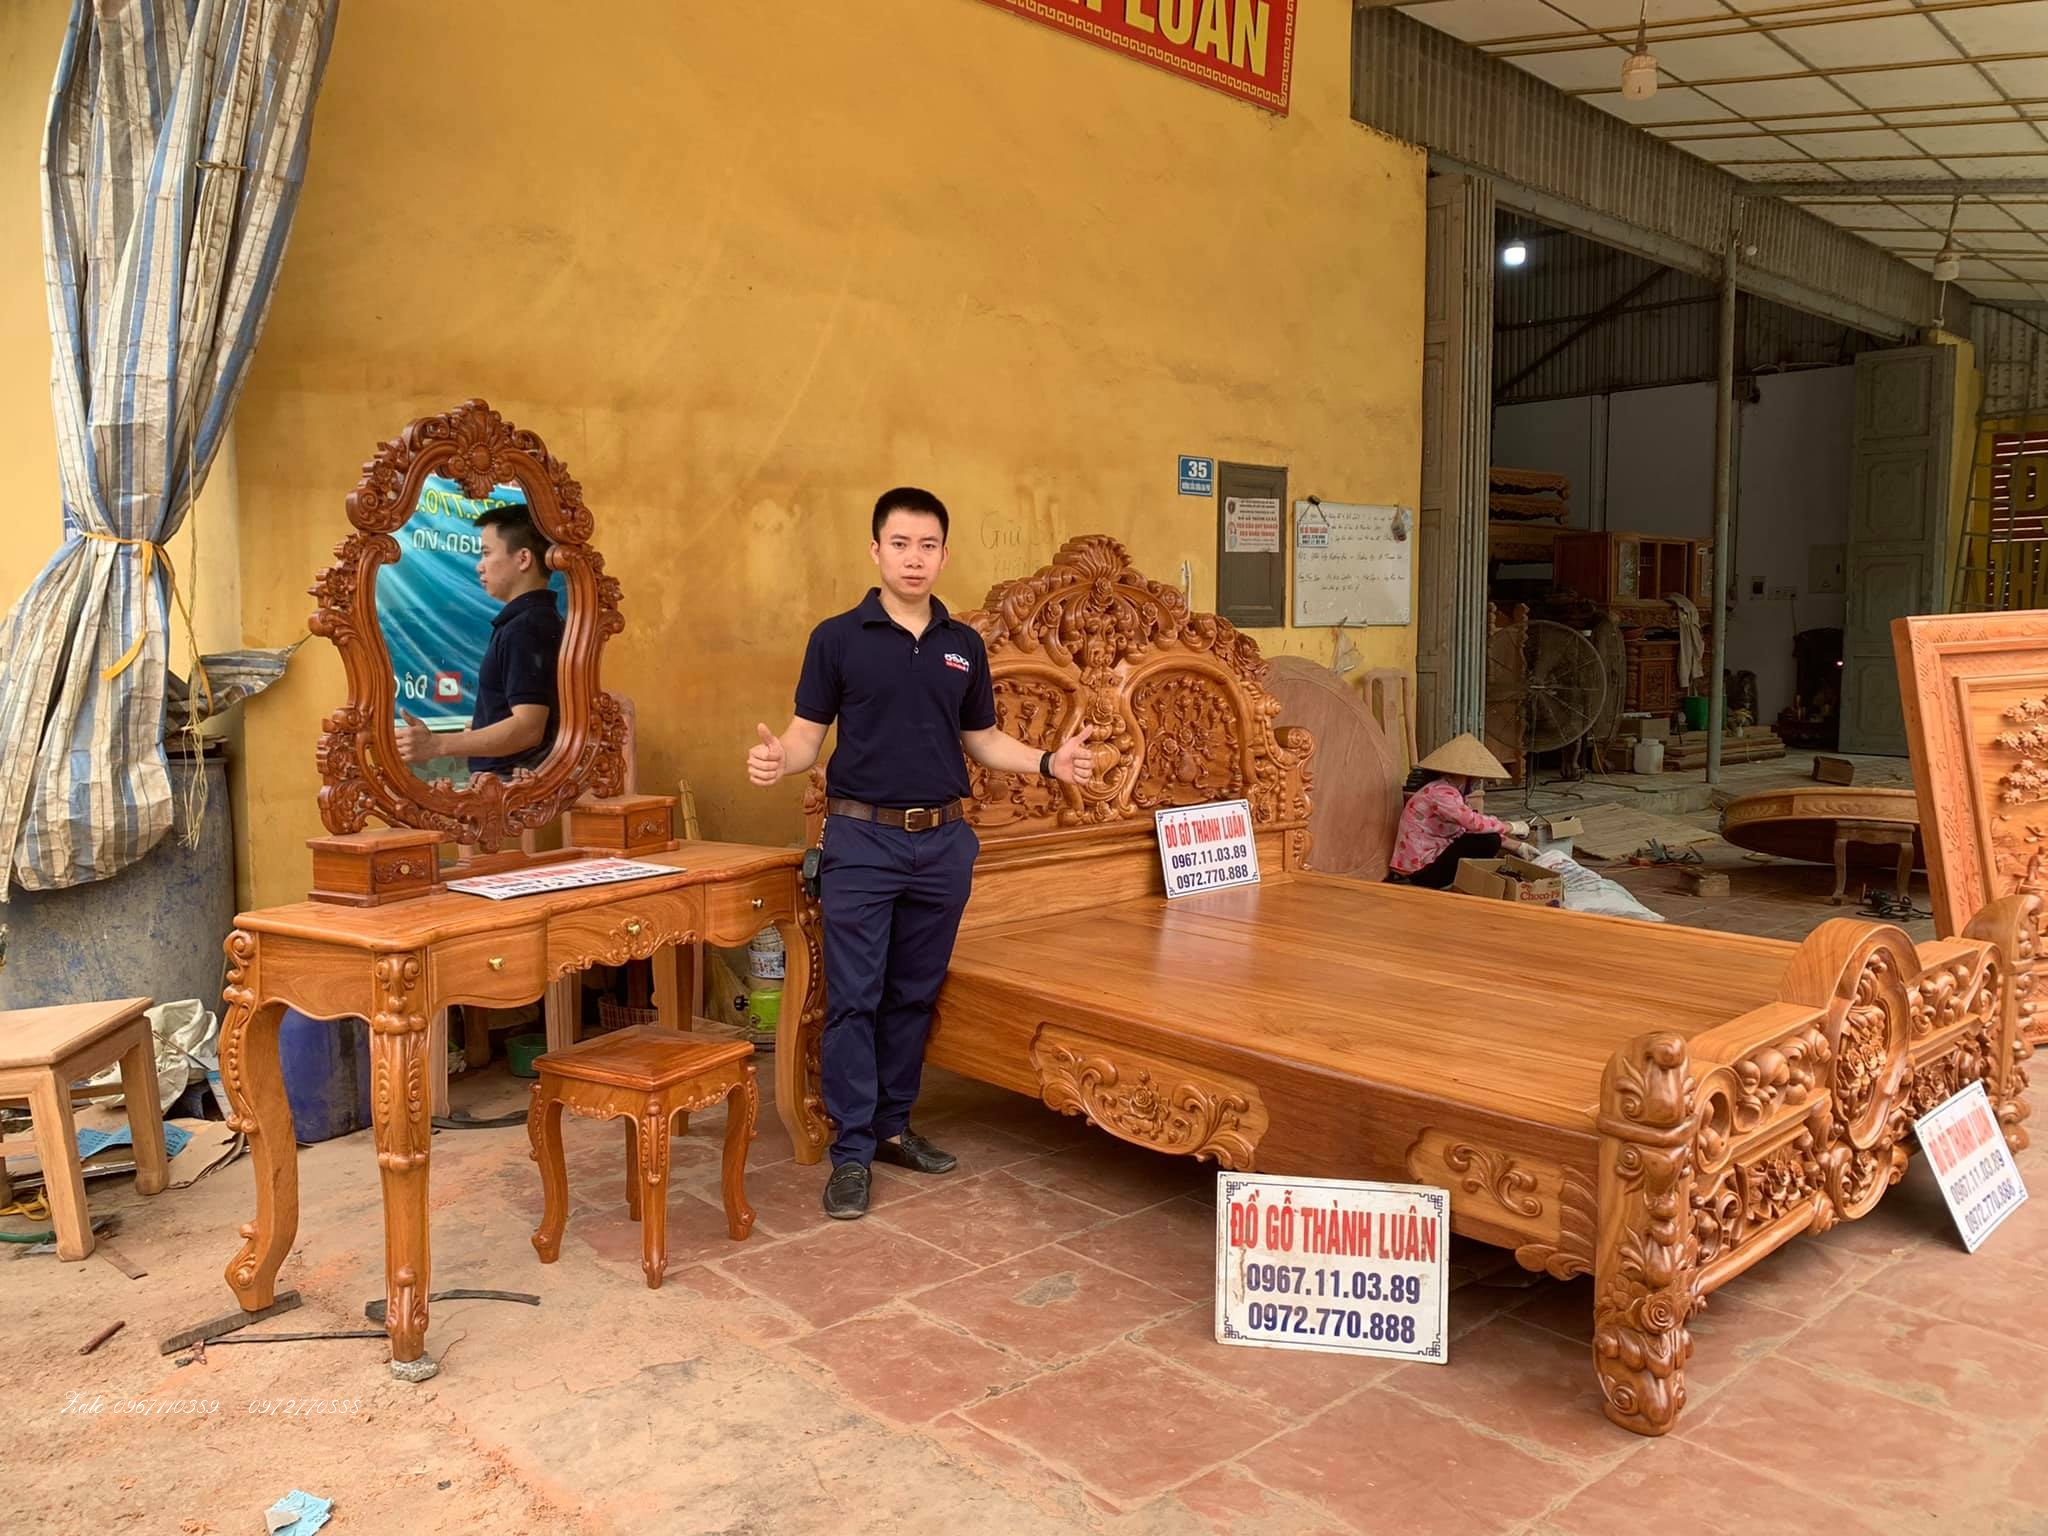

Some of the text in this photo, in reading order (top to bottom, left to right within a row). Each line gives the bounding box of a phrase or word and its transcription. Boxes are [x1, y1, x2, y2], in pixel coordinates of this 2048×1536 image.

[1188, 461, 1207, 478] 35
[1192, 814, 1222, 844] THÀNH
[1221, 810, 1246, 840] LUÂN
[1172, 844, 1247, 869] 0967.11.03.89
[1176, 864, 1249, 889] 0972.770.888
[1230, 1189, 1437, 1263] ĐỒ GỖ THÀNH LUÂN
[1246, 1263, 1421, 1304] 0967.11.03.89
[1248, 1302, 1416, 1344] 0972.770.888
